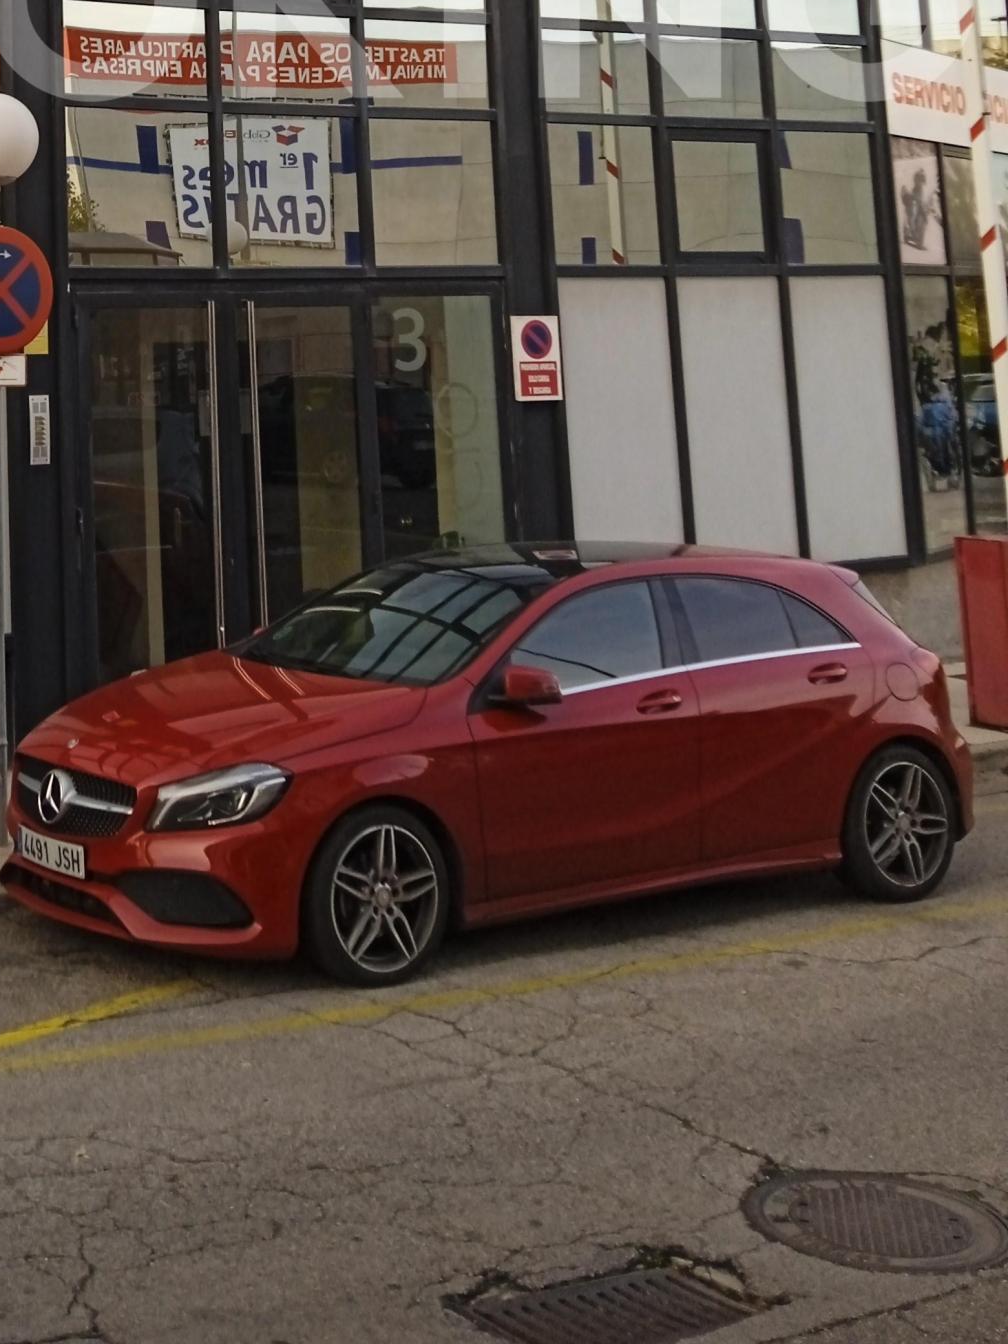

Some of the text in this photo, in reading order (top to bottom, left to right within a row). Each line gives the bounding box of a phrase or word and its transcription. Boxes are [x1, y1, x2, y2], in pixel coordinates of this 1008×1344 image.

[892, 72, 967, 116] SERVICIO
[393, 307, 427, 372] 3
[24, 833, 80, 873] 4491 JSH
